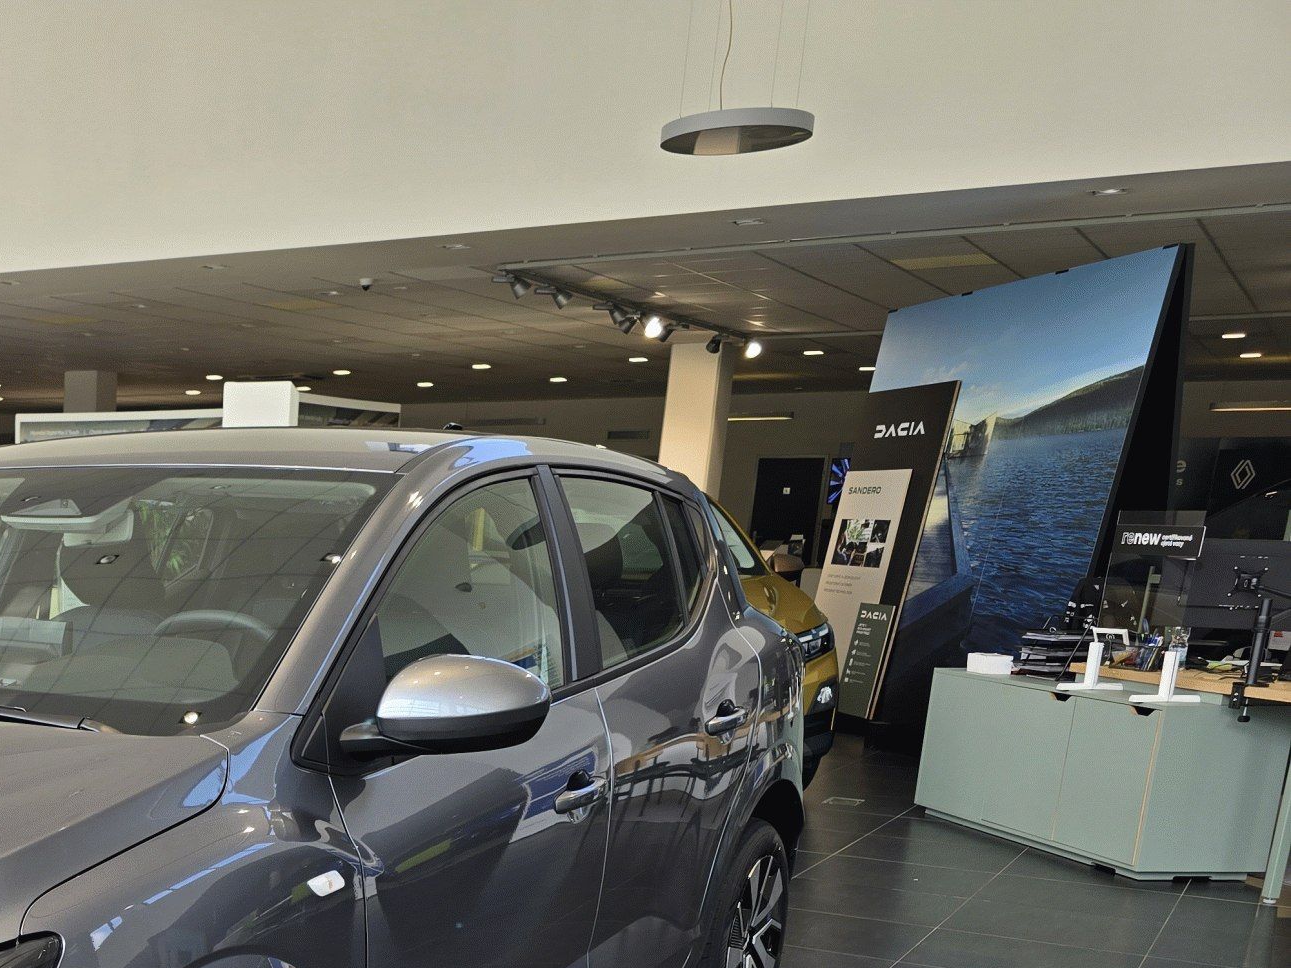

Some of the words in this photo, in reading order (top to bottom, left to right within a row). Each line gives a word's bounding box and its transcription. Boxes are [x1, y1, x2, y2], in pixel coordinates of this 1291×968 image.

[873, 421, 926, 439] DACIA
[848, 486, 882, 495] SANDERO
[1121, 532, 1161, 546] renew
[860, 610, 887, 621] DACIA
